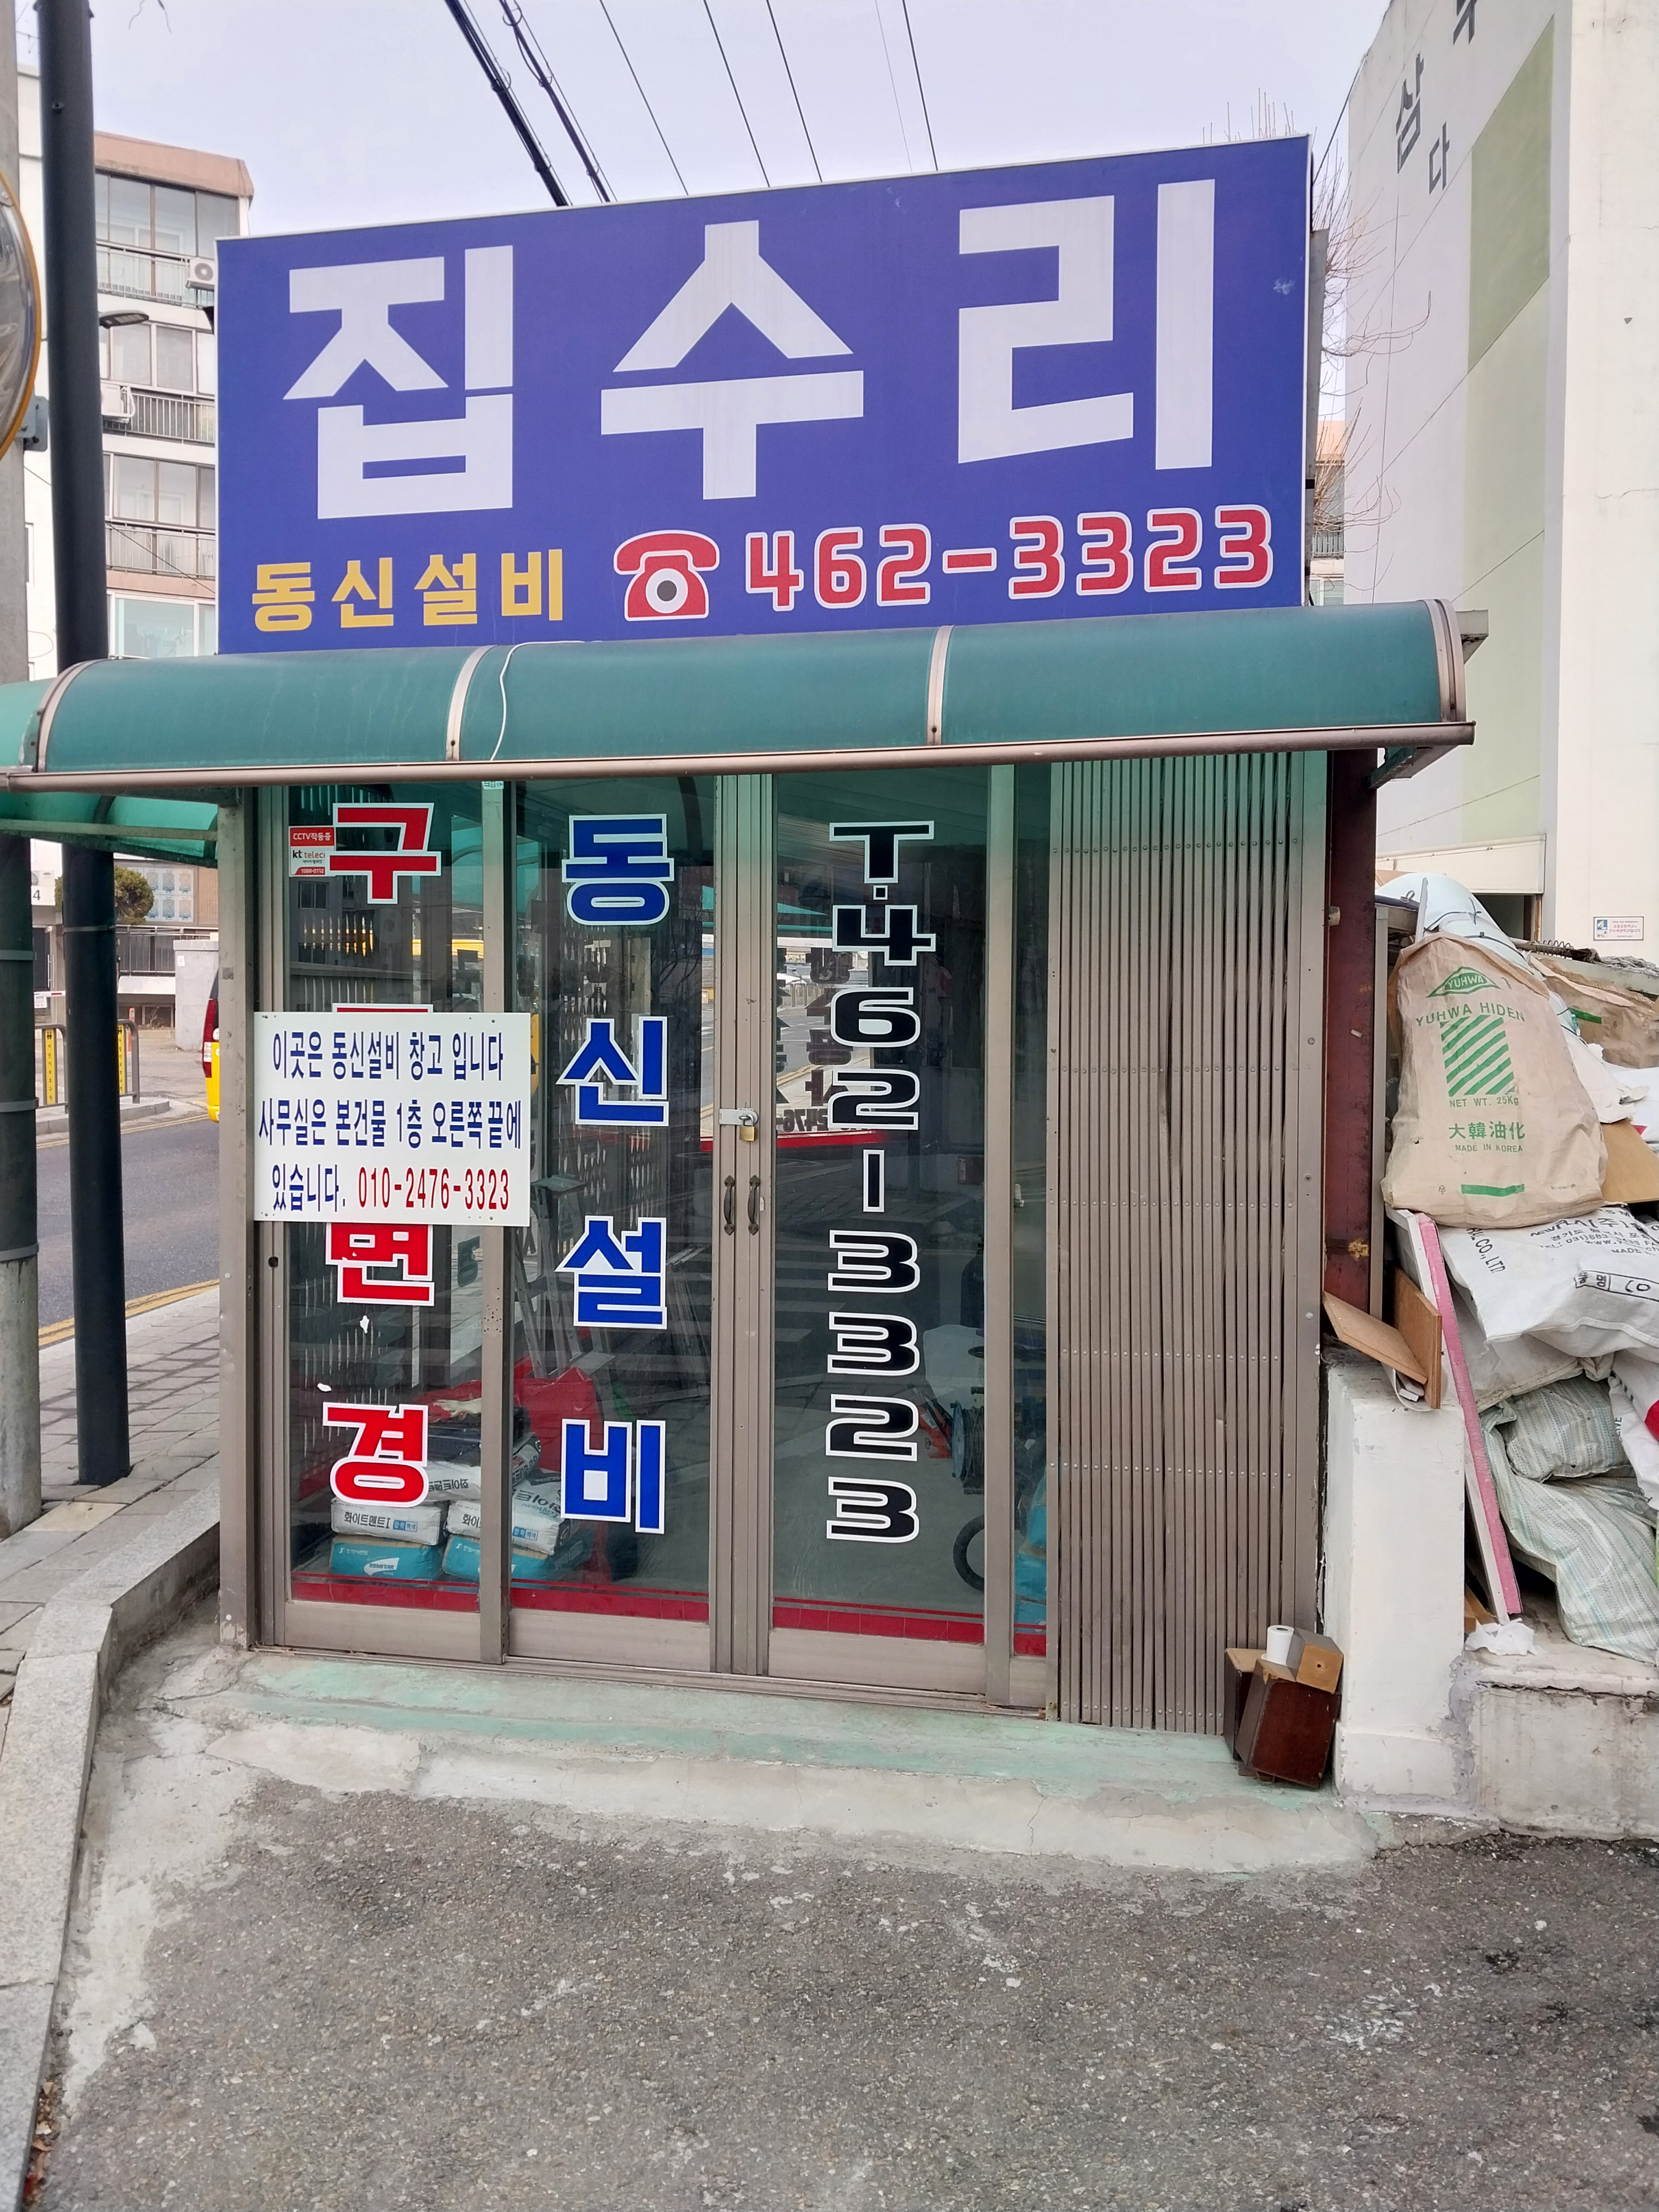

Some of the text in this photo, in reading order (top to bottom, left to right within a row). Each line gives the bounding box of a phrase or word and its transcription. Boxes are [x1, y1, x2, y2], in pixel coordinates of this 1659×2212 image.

[282, 178, 1216, 521] 집수리
[744, 503, 1274, 613] 462-3323
[250, 548, 565, 633] 동신설비
[293, 832, 331, 841] CCTV작동중
[292, 850, 303, 858] kt
[1447, 975, 1484, 989] YUHWA
[1416, 1001, 1526, 1027] YUHWA HIDEN
[273, 1030, 504, 1082] 이곳은 동신설비 창고 입니다
[1449, 1095, 1519, 1108] NET WT. 25Kg
[258, 1097, 326, 1146] 사무실은
[335, 1099, 387, 1148] 본건물
[396, 1098, 423, 1149] 1층
[1448, 1120, 1526, 1140] 大韓油化
[1496, 1144, 1523, 1153] KOREA
[272, 1162, 509, 1212] 있습니다. 010-2476-3323
